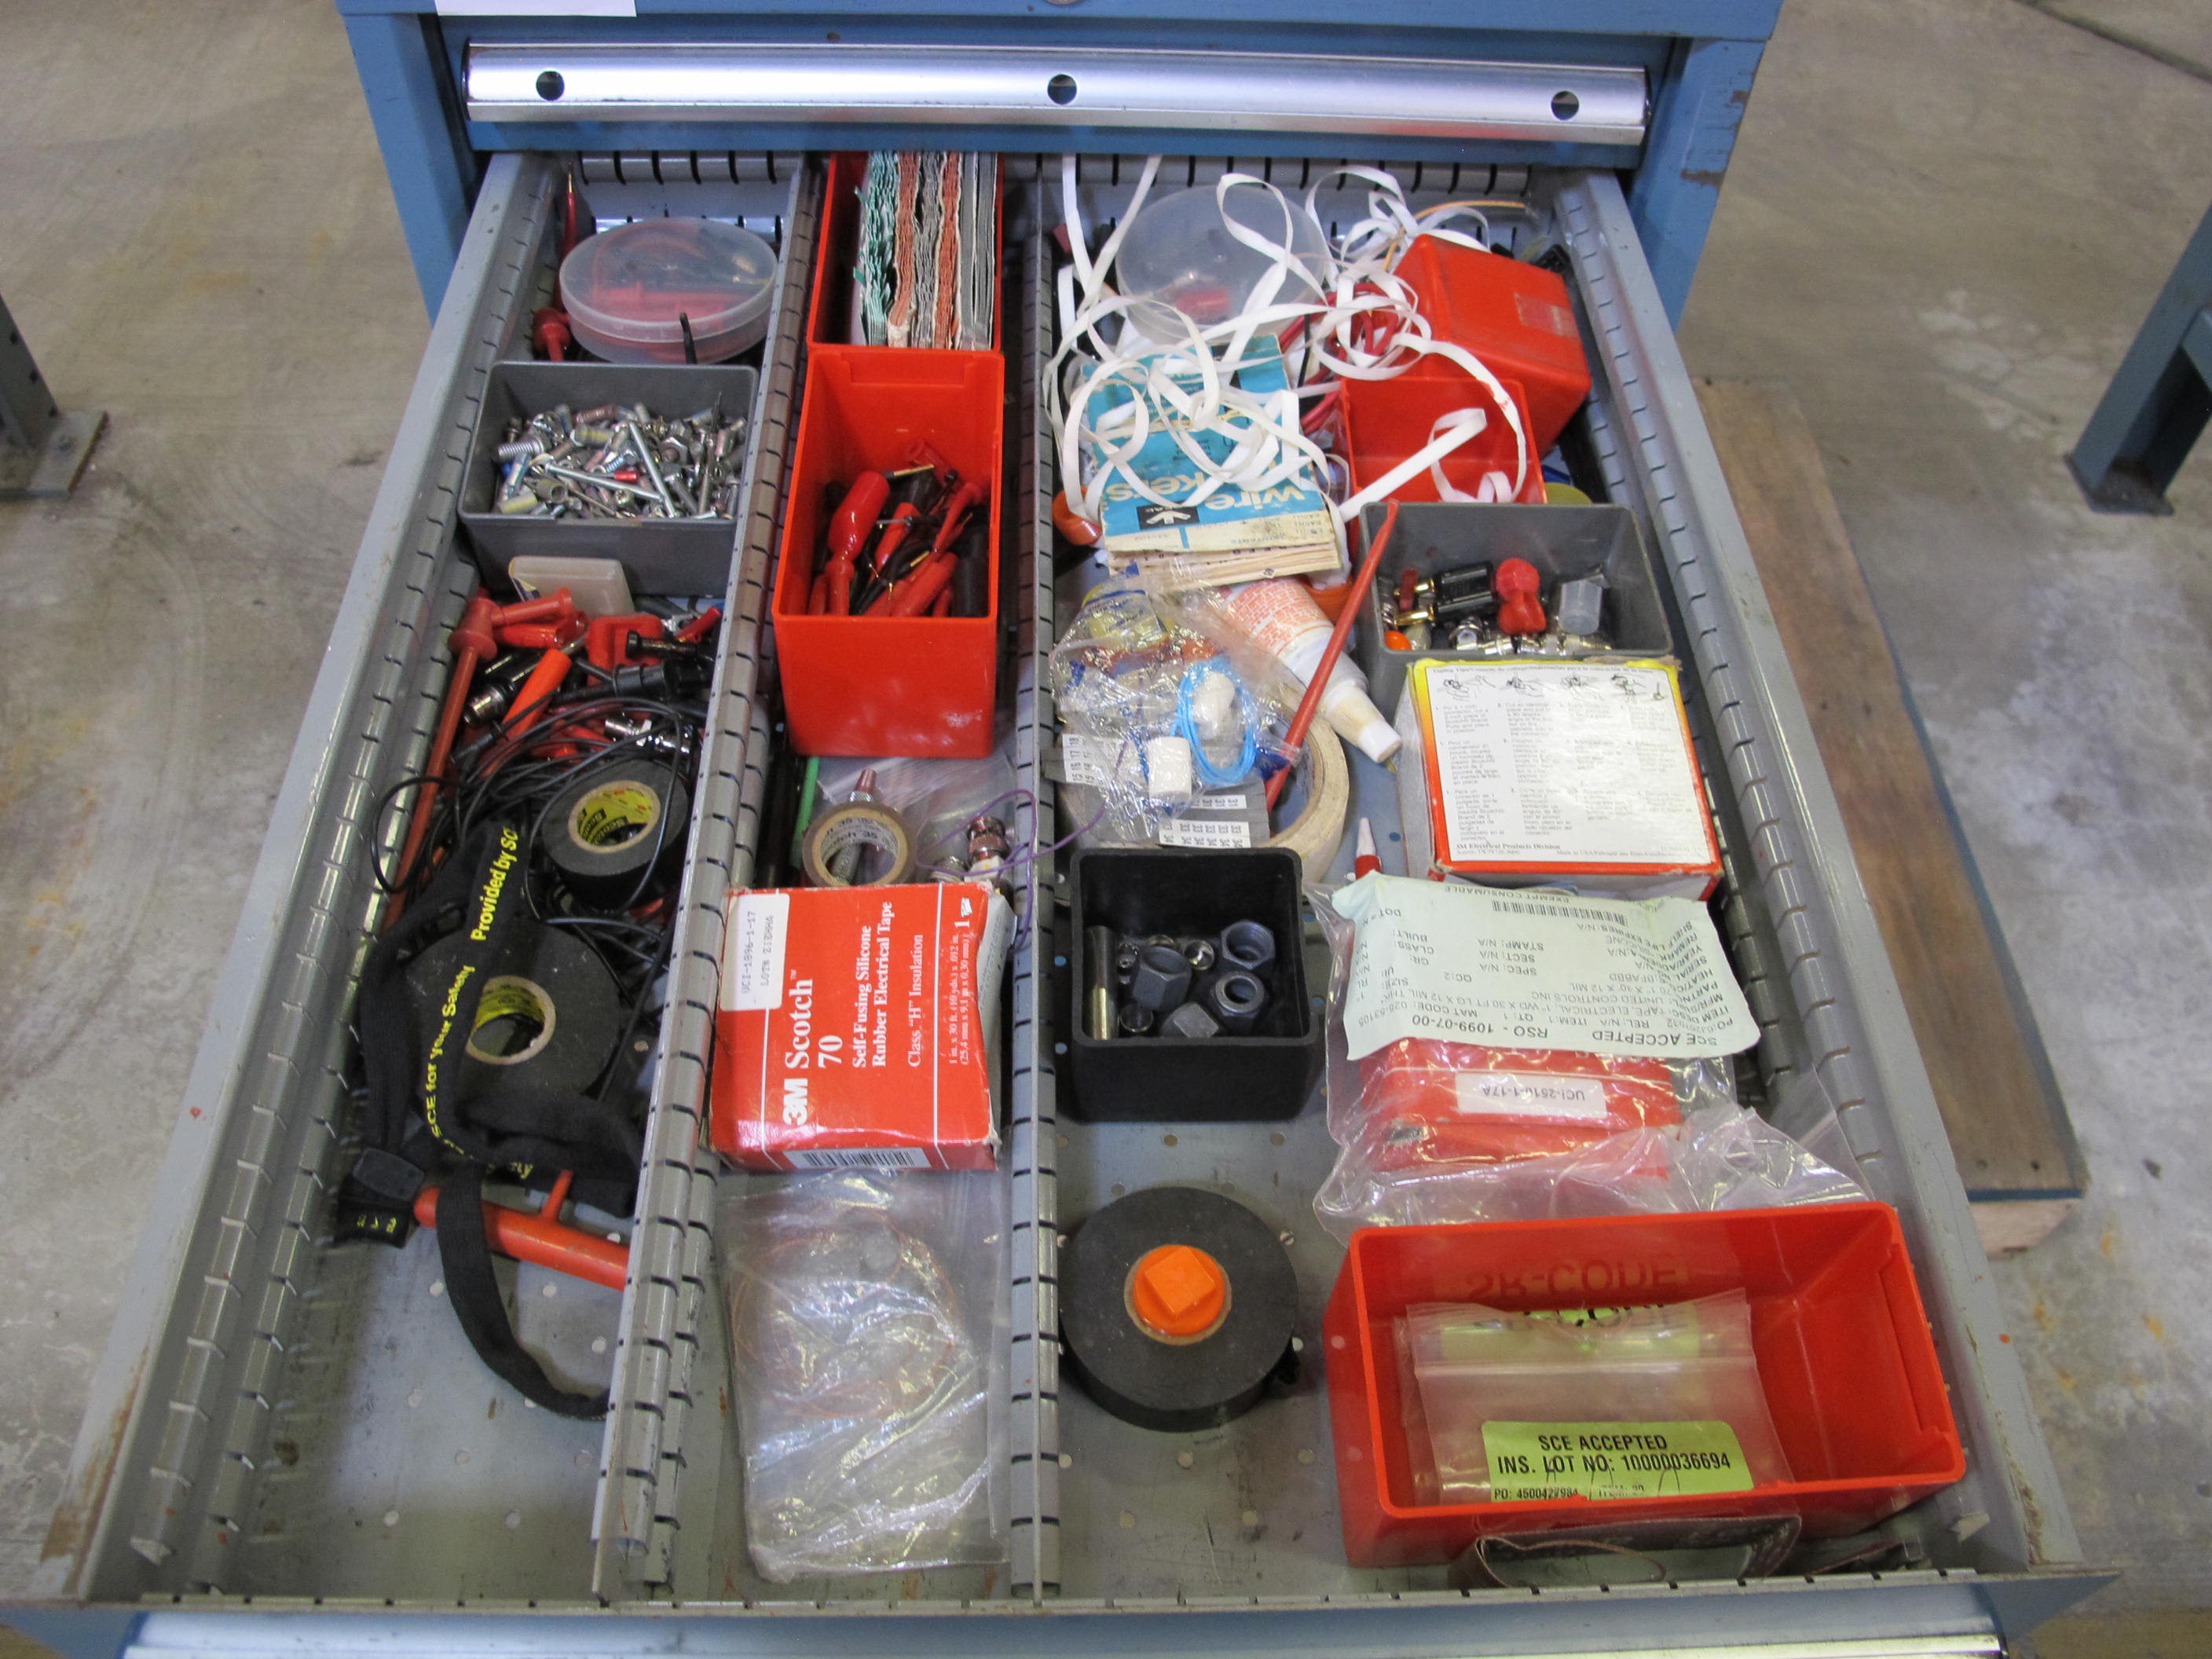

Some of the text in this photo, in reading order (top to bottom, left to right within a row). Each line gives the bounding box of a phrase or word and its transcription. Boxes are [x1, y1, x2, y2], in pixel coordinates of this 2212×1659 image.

[1204, 482, 1305, 511] wire
[470, 867, 507, 940] Provided
[493, 851, 518, 870] by
[1444, 886, 1522, 899] CONSUMABLE
[1392, 929, 1427, 943] BUILT:
[1393, 940, 1434, 956] CLASS:
[1477, 939, 1544, 950] STAMP: N/A
[1479, 950, 1535, 962] SECT: N/A
[909, 934, 924, 996] Insulation
[1479, 964, 1536, 976] SPEC: N/A
[873, 901, 895, 1068] Rubber Electrical Tape
[853, 925, 872, 1068] Self-Fusing Silicone
[1408, 990, 1427, 999] MIL
[1531, 991, 1550, 1000] INC
[1554, 992, 1617, 1002] CONTROLS
[1621, 995, 1663, 1004] UNITED
[1413, 1002, 1449, 1013] CODE:
[1454, 1008, 1477, 1017] MAT
[1702, 1005, 1728, 1022] ITEM
[1513, 1013, 1533, 1021] QT:
[1555, 1016, 1587, 1026] ITEM:
[1599, 1018, 1620, 1027] N/A
[1623, 1018, 1649, 1027] REL:
[950, 1023, 958, 1035] 30
[1412, 1015, 1494, 1033] 1099-07-00
[1514, 1027, 1547, 1038] RSO
[1592, 1030, 1680, 1046] ACCEPTED
[1686, 1033, 1717, 1046] SCE
[425, 965, 476, 1137] SCE for your Safety
[819, 1035, 843, 1068] 70
[907, 1030, 923, 1067] Class
[783, 1079, 808, 1125] 3M
[1538, 1434, 1667, 1452] SCE ACCEPTED
[1497, 1452, 1730, 1474] INS. LOT NO: 10000036694
[1494, 1488, 1513, 1500] PO:
